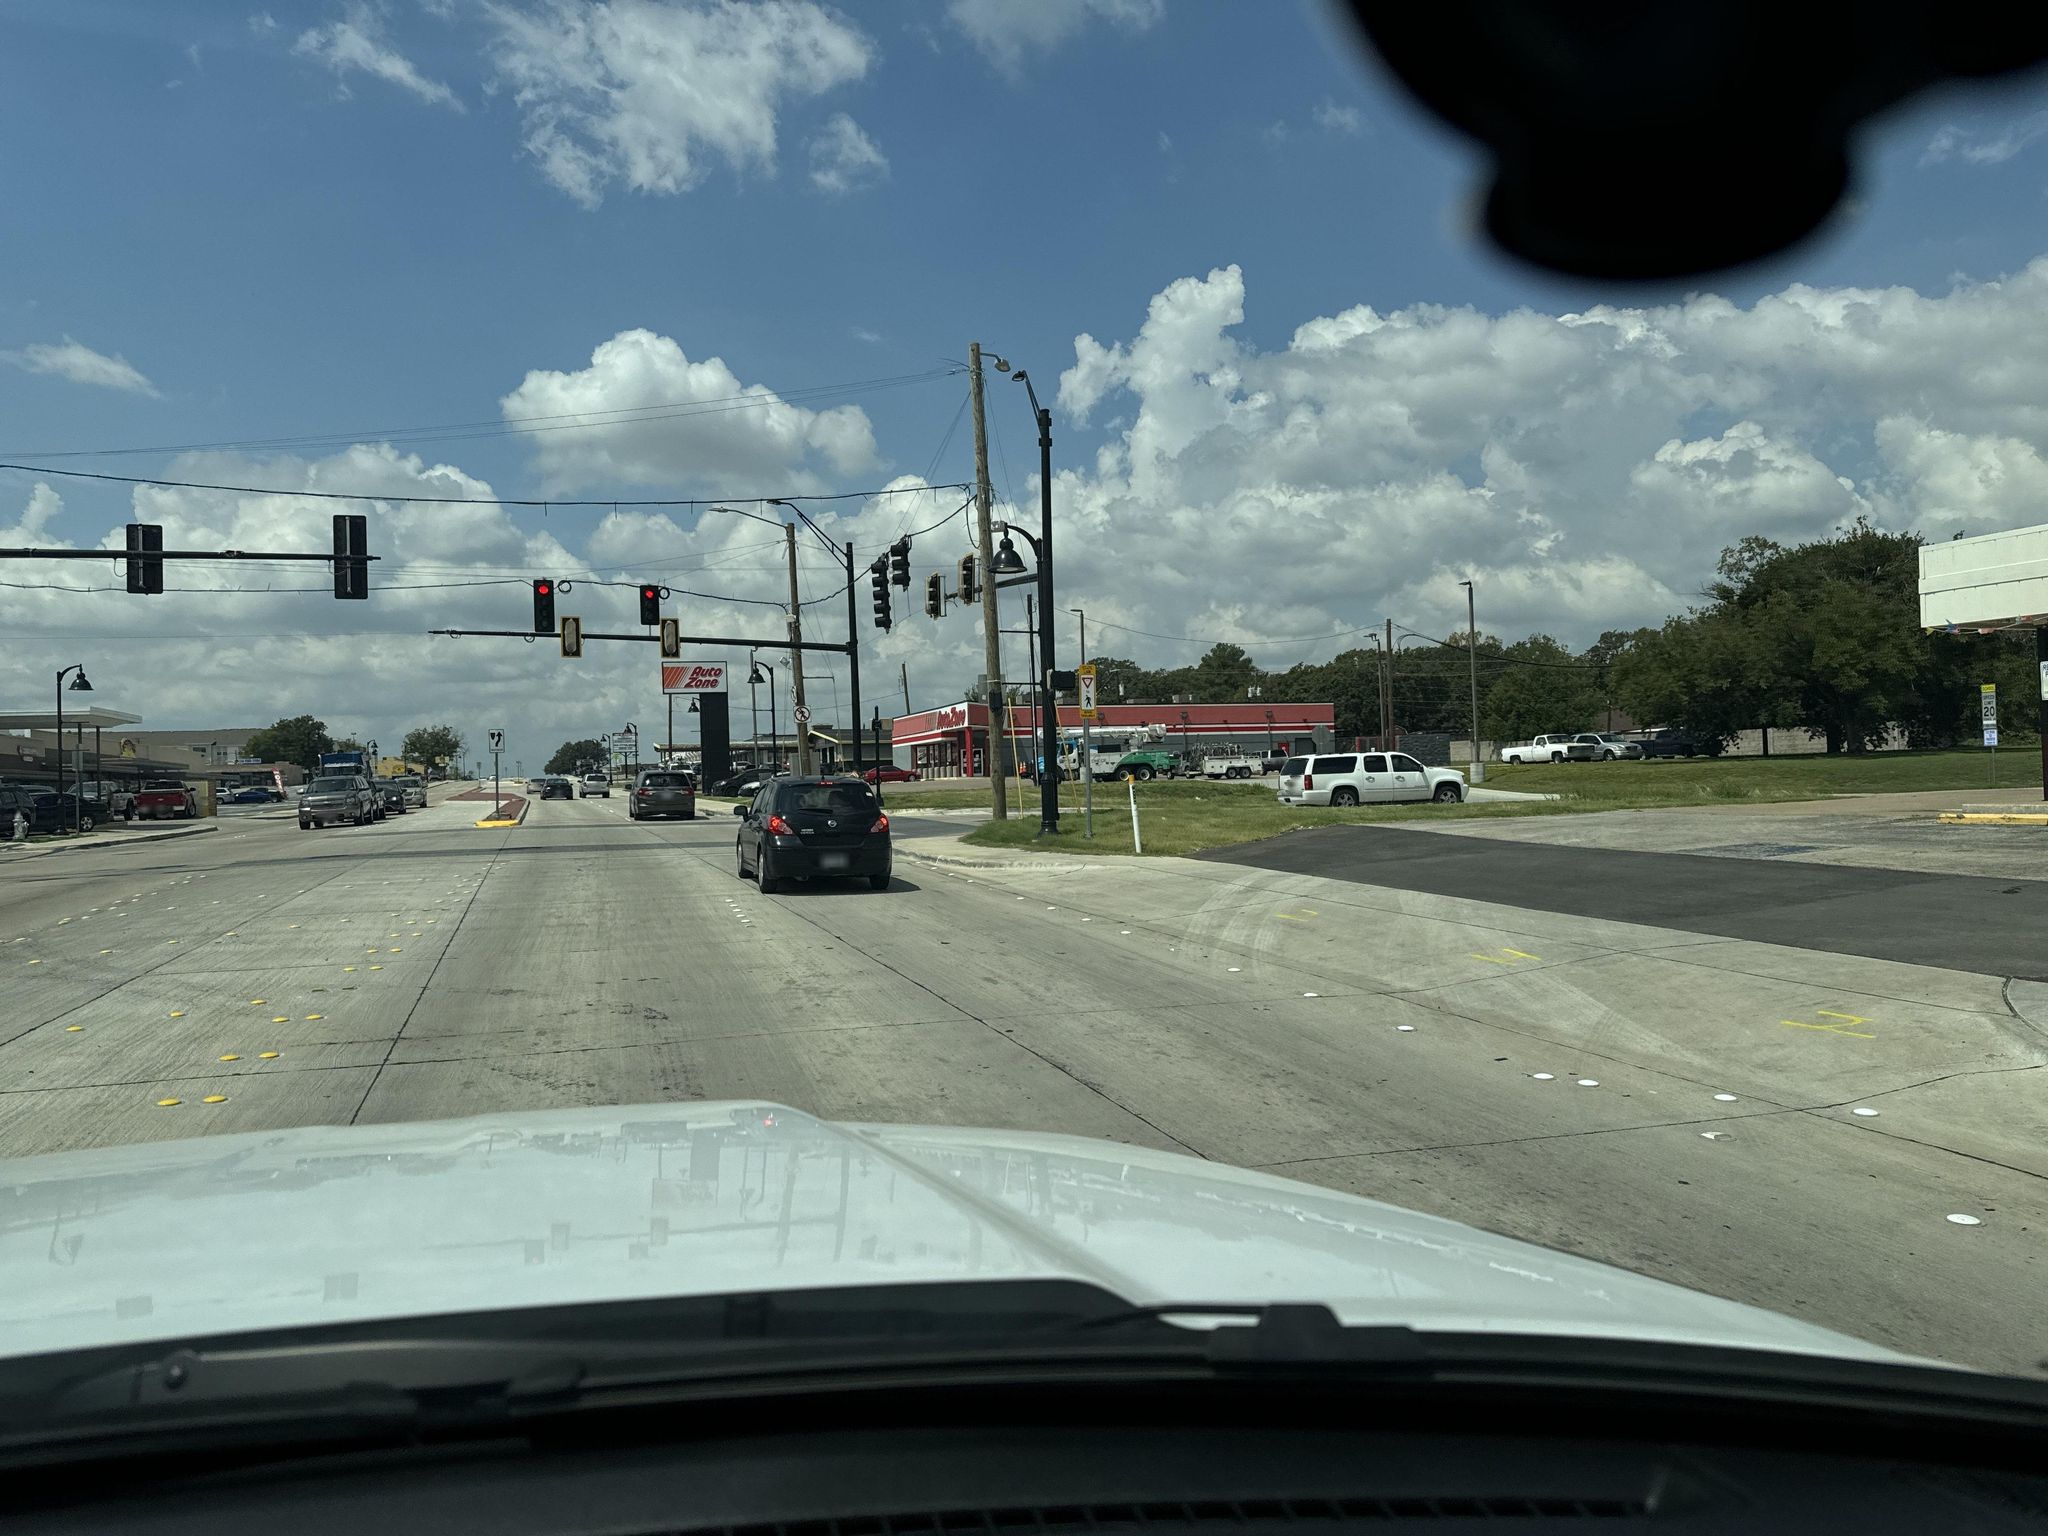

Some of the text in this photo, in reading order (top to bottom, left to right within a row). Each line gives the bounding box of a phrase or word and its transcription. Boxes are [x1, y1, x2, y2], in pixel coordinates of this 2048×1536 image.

[690, 666, 723, 677] Auto
[684, 677, 720, 689] Zone
[1984, 706, 1994, 716] 20
